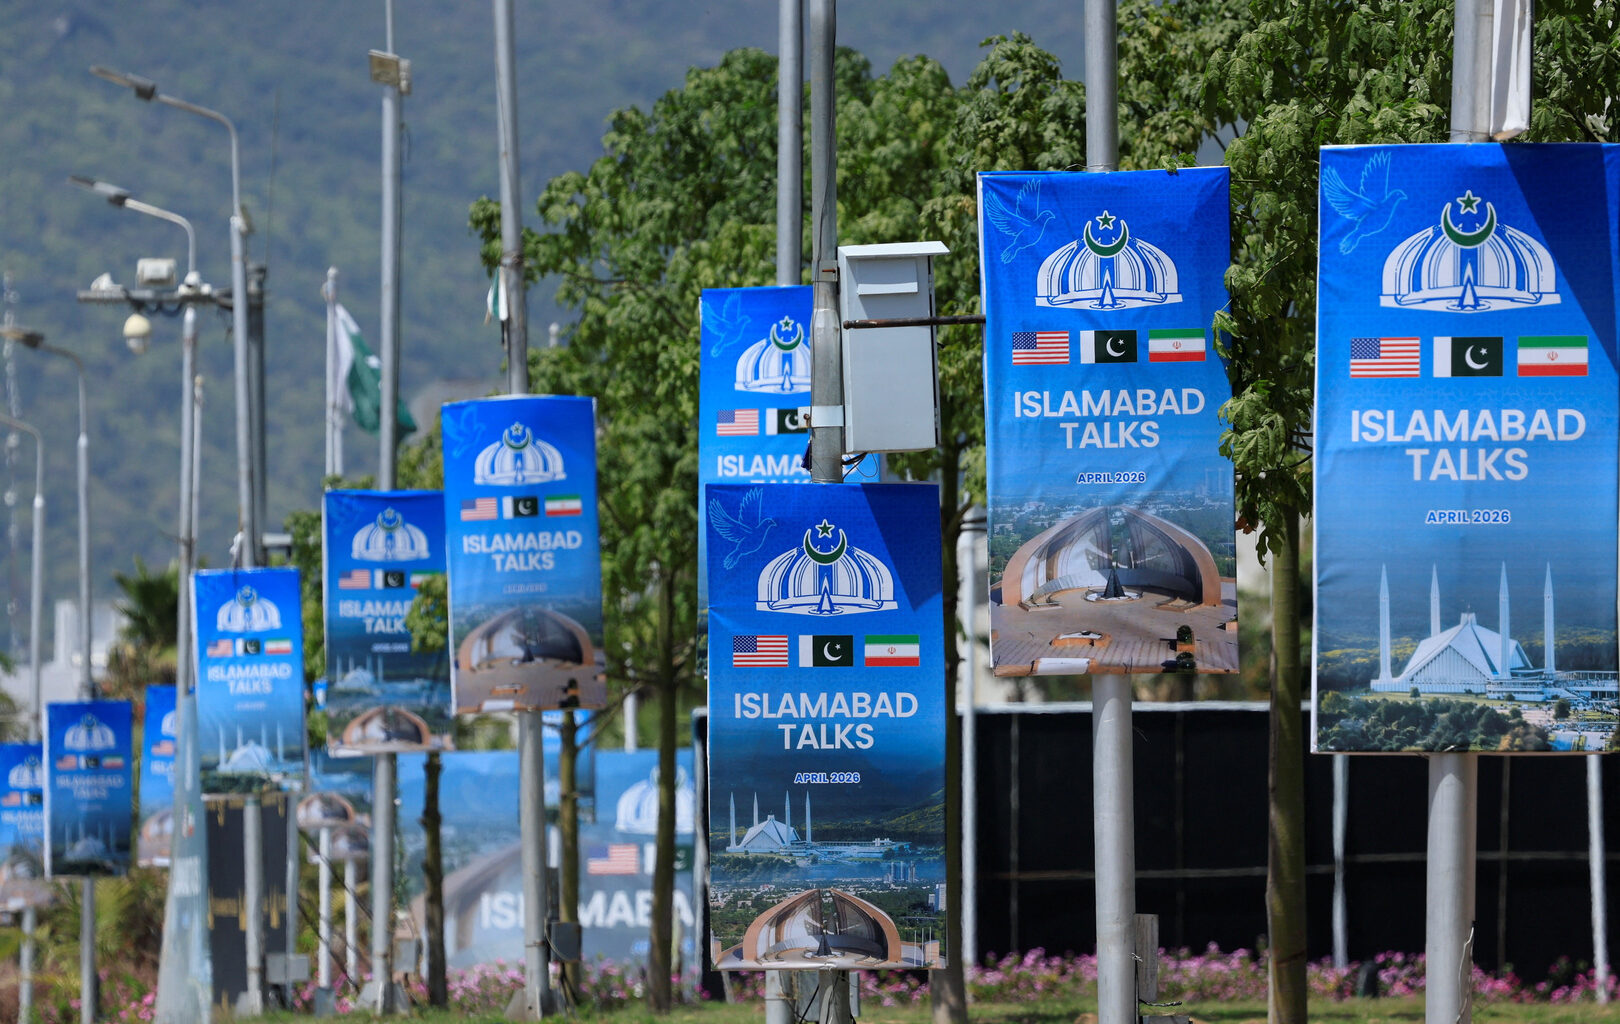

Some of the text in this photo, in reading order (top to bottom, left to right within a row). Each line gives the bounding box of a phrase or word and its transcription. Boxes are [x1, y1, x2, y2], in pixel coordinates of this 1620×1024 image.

[1014, 388, 1206, 418] ISLAMABAD
[1060, 421, 1160, 449] TALKS
[1351, 409, 1586, 442] ISLAMABAD
[1405, 448, 1529, 481] TALKS
[1077, 471, 1146, 484] APRIL 2026
[1425, 509, 1511, 524] APRIL 2026
[463, 531, 582, 554] ISLAMABAD
[492, 552, 555, 572] TALKS
[363, 617, 409, 634] TALK
[734, 692, 919, 719] ISLAMABAD
[778, 723, 875, 750] TALKS
[794, 772, 861, 784] APRIL 2026
